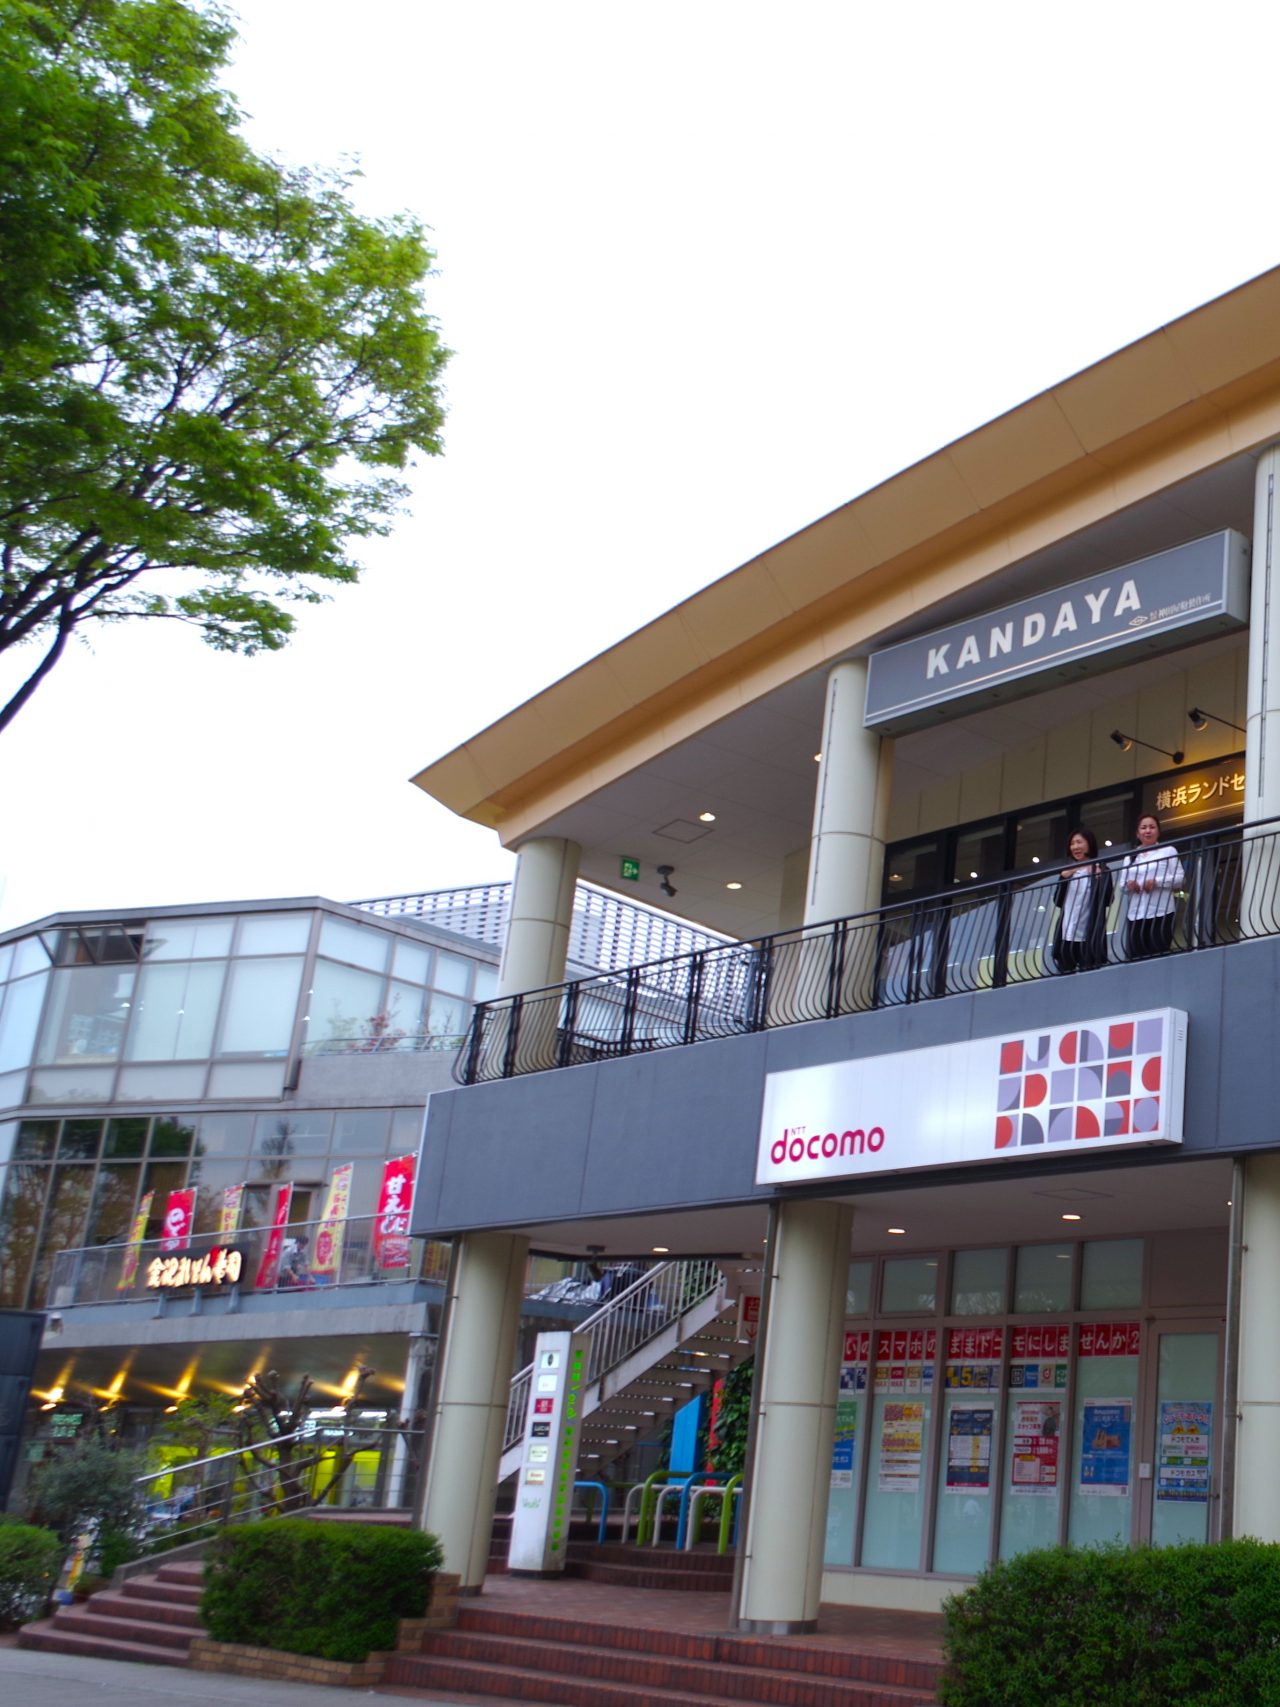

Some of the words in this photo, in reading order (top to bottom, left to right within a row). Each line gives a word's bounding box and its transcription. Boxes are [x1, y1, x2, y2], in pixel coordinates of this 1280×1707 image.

[926, 579, 1141, 679] KANDAYA
[1156, 773, 1245, 811] 横浜ランドセ
[770, 1126, 885, 1164] docomo
[790, 1126, 806, 1136] NTT
[382, 1174, 409, 1234] 甘えび
